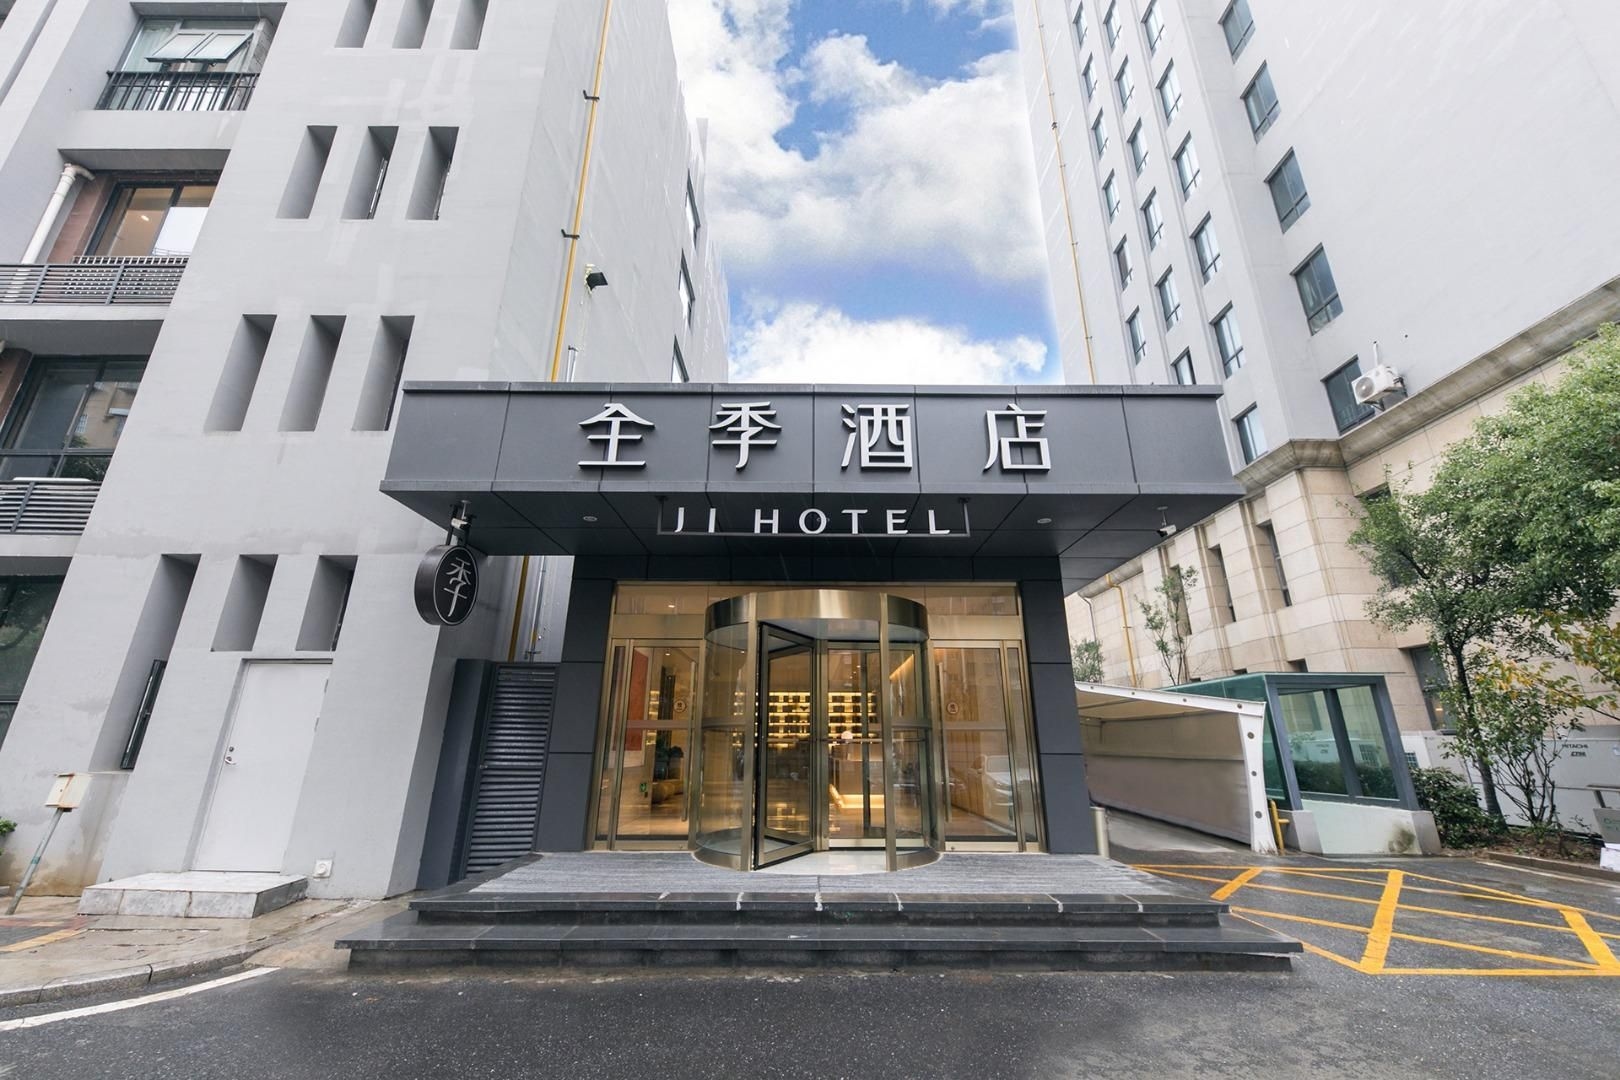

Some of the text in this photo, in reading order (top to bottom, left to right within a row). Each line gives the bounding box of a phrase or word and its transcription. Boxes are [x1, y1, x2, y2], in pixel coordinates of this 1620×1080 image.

[577, 401, 1052, 472] 全季酒店
[674, 507, 951, 535] JI HOTEL
[443, 557, 472, 617] 季
